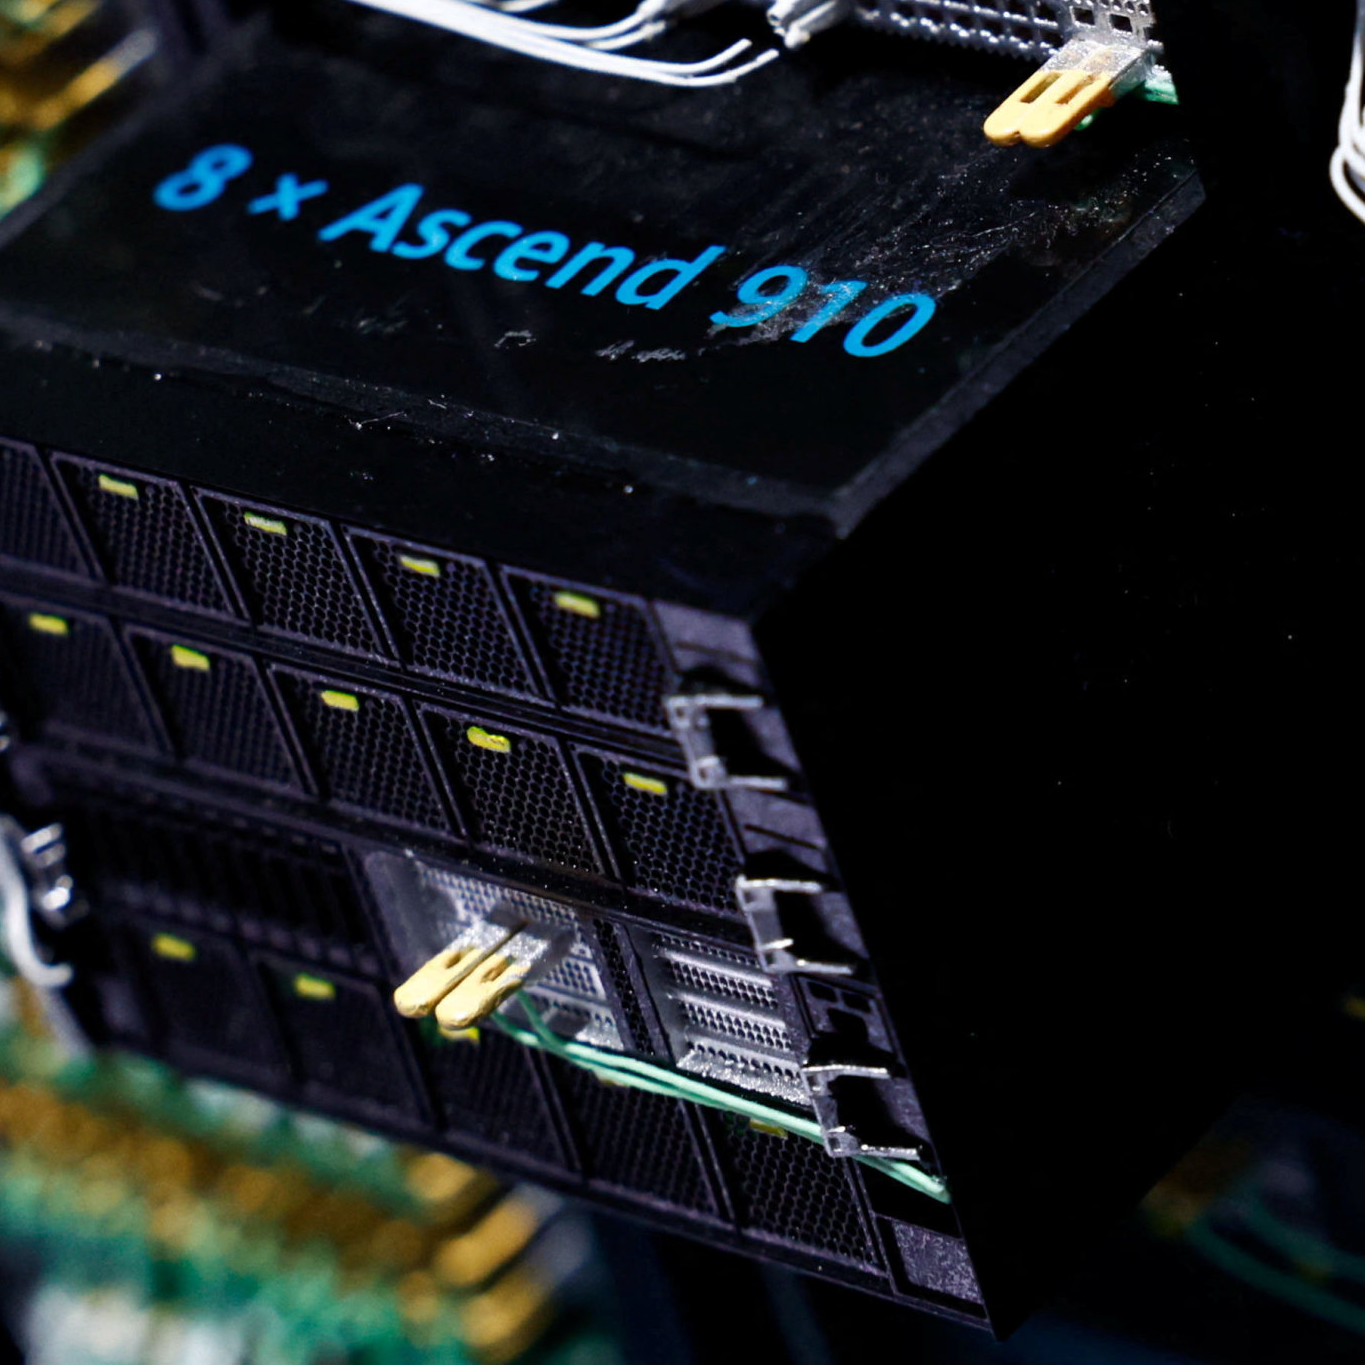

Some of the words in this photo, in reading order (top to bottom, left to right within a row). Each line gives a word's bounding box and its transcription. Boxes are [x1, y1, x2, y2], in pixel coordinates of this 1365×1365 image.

[153, 143, 253, 212] 8
[318, 182, 727, 311] Ascend
[708, 263, 939, 359] 910
